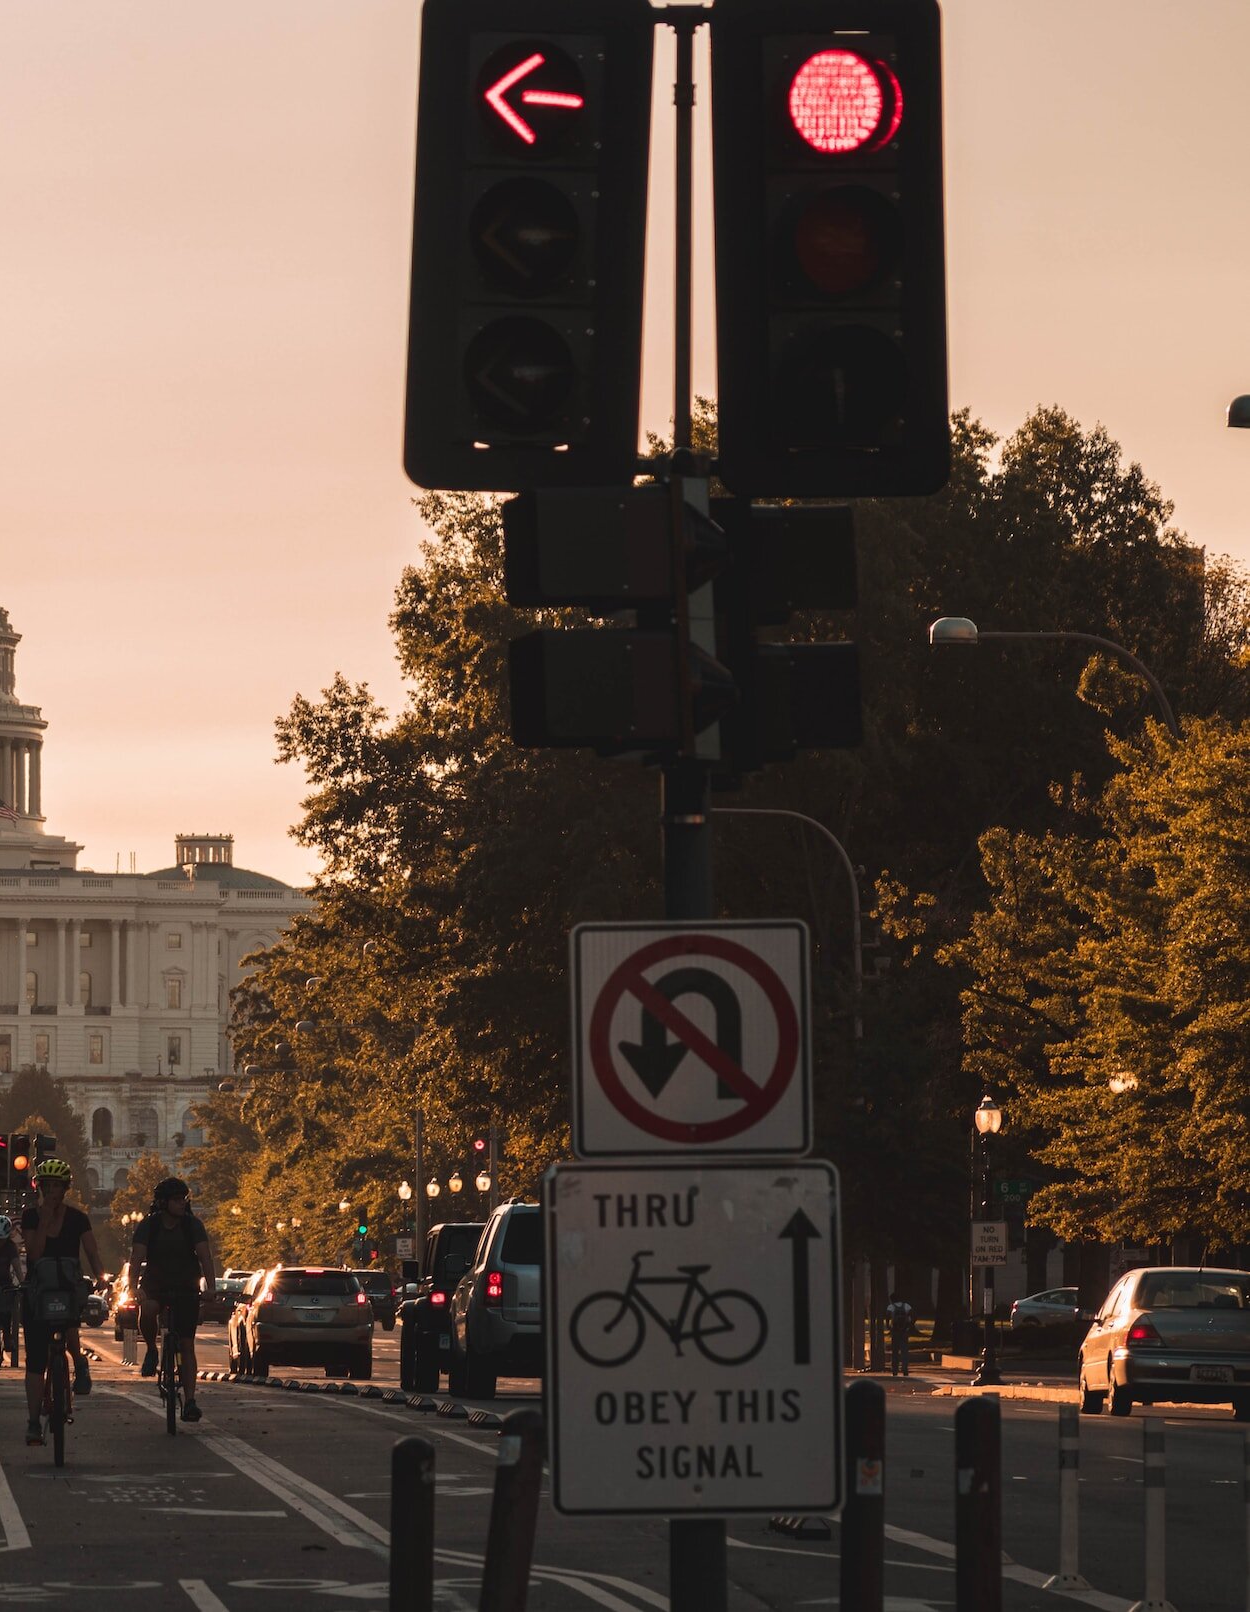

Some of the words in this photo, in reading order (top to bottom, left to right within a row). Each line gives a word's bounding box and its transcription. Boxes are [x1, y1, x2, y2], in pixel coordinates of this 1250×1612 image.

[1000, 1182, 1009, 1193] 6
[593, 1193, 697, 1228] THRU
[594, 1390, 697, 1425] OBEY
[715, 1389, 801, 1424] THIS
[636, 1445, 763, 1479] SIGNAL
